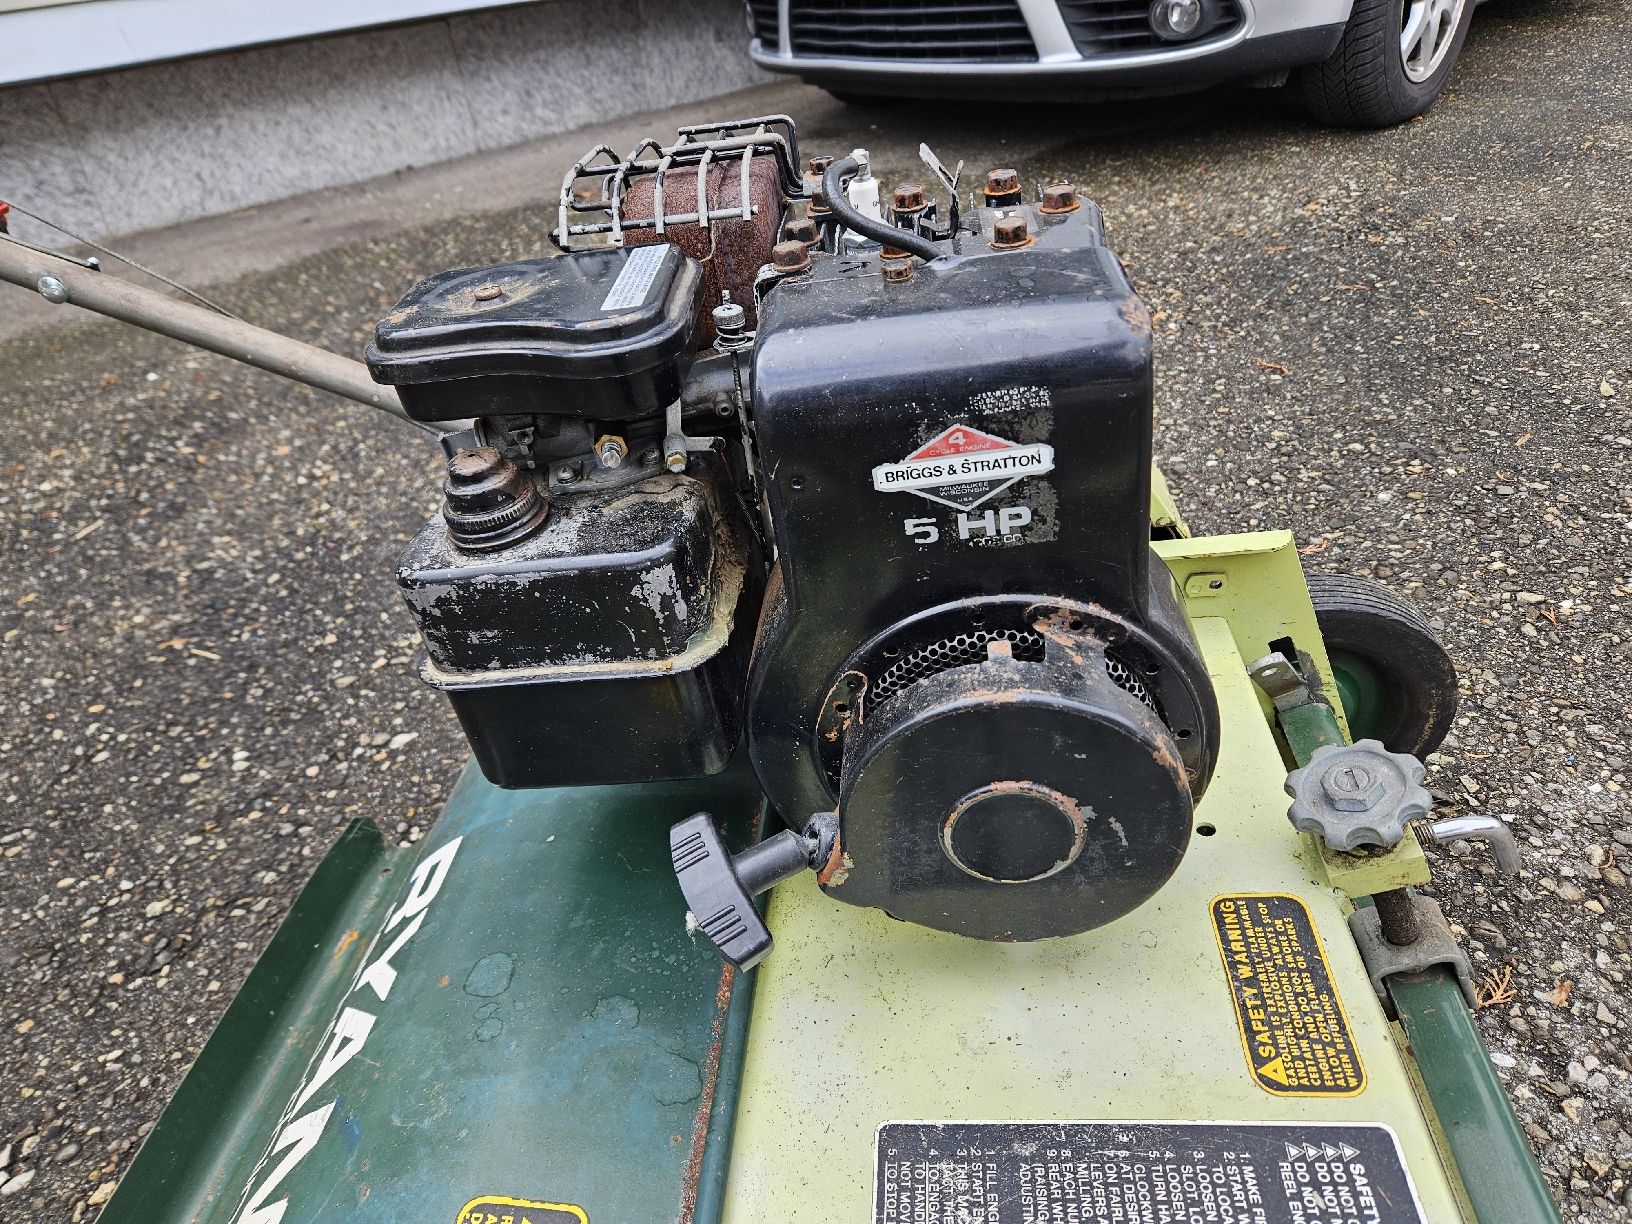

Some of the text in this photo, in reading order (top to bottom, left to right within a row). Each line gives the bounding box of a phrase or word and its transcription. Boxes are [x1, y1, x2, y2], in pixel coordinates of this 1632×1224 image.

[929, 443, 991, 456] CYCLE ENGINE
[949, 432, 966, 445] 4
[885, 453, 1042, 483] BRIGGS & STRATTON
[939, 481, 989, 491] MILWAUKEE
[939, 486, 989, 496] WISCONSIN
[904, 506, 1032, 544] 5 HP
[1258, 902, 1271, 923] STOP
[1269, 928, 1283, 965] ALWAYS
[1279, 935, 1296, 967] SMOKE
[1220, 900, 1276, 1057] SAFETY WARNING
[1237, 900, 1298, 1086] GASOLINE IS EXTREMELY FLAMMABLE
[1291, 972, 1303, 992] NOT
[1255, 926, 1310, 1086] AND HIGHLY EXPLOSIVE UNDER
[1285, 917, 1346, 1086] ALLOW OPEN FLAMES OR SPARKS
[1298, 996, 1309, 1012] DO
[1305, 1016, 1318, 1038] AND
[1321, 991, 1358, 1087] WHEN REFUELING.
[1301, 1039, 1321, 1086] CERTAIN
[1315, 1044, 1335, 1086] ENGINE
[888, 1149, 897, 1158] 5.
[929, 1149, 939, 1158] 4.
[957, 1149, 967, 1158] 3.
[971, 1149, 981, 1158] 2.
[986, 1150, 995, 1159] 1.
[1047, 1149, 1057, 1159] 9.
[1149, 1151, 1160, 1160] 5.
[888, 1162, 897, 1178] TO
[915, 1162, 925, 1179] TO
[929, 1162, 939, 1179] TO
[943, 1162, 953, 1194] TACT
[958, 1162, 968, 1191] THIS
[972, 1163, 983, 1204] START
[986, 1163, 997, 1189] FILL
[1048, 1164, 1061, 1198] REAR
[1105, 1164, 1118, 1183] ON
[1120, 1163, 1133, 1180] AT
[1151, 1164, 1168, 1200] TURN
[1181, 1165, 1198, 1202] SLOT.
[1212, 1164, 1225, 1183] TO
[1279, 1162, 1297, 1197] REEL
[1294, 1163, 1310, 1182] DO
[1315, 1163, 1330, 1182] DO
[1331, 1163, 1346, 1182] DO
[900, 1162, 911, 1224] NOT MOV
[1031, 1164, 1049, 1220] (RAISING
[1061, 1150, 1079, 1224] 8. EACH NU
[1091, 1163, 1107, 1215] LEVERS
[1164, 1151, 1187, 1220] 4. LOOSEN
[1193, 1151, 1219, 1220] 3. LOOSEN
[1227, 1166, 1247, 1209] START
[1242, 1166, 1262, 1204] MAKE
[887, 1183, 898, 1217] STOP
[1301, 1187, 1319, 1216] NOT
[1322, 1186, 1340, 1215] NOT
[1338, 1186, 1357, 1215] NOT
